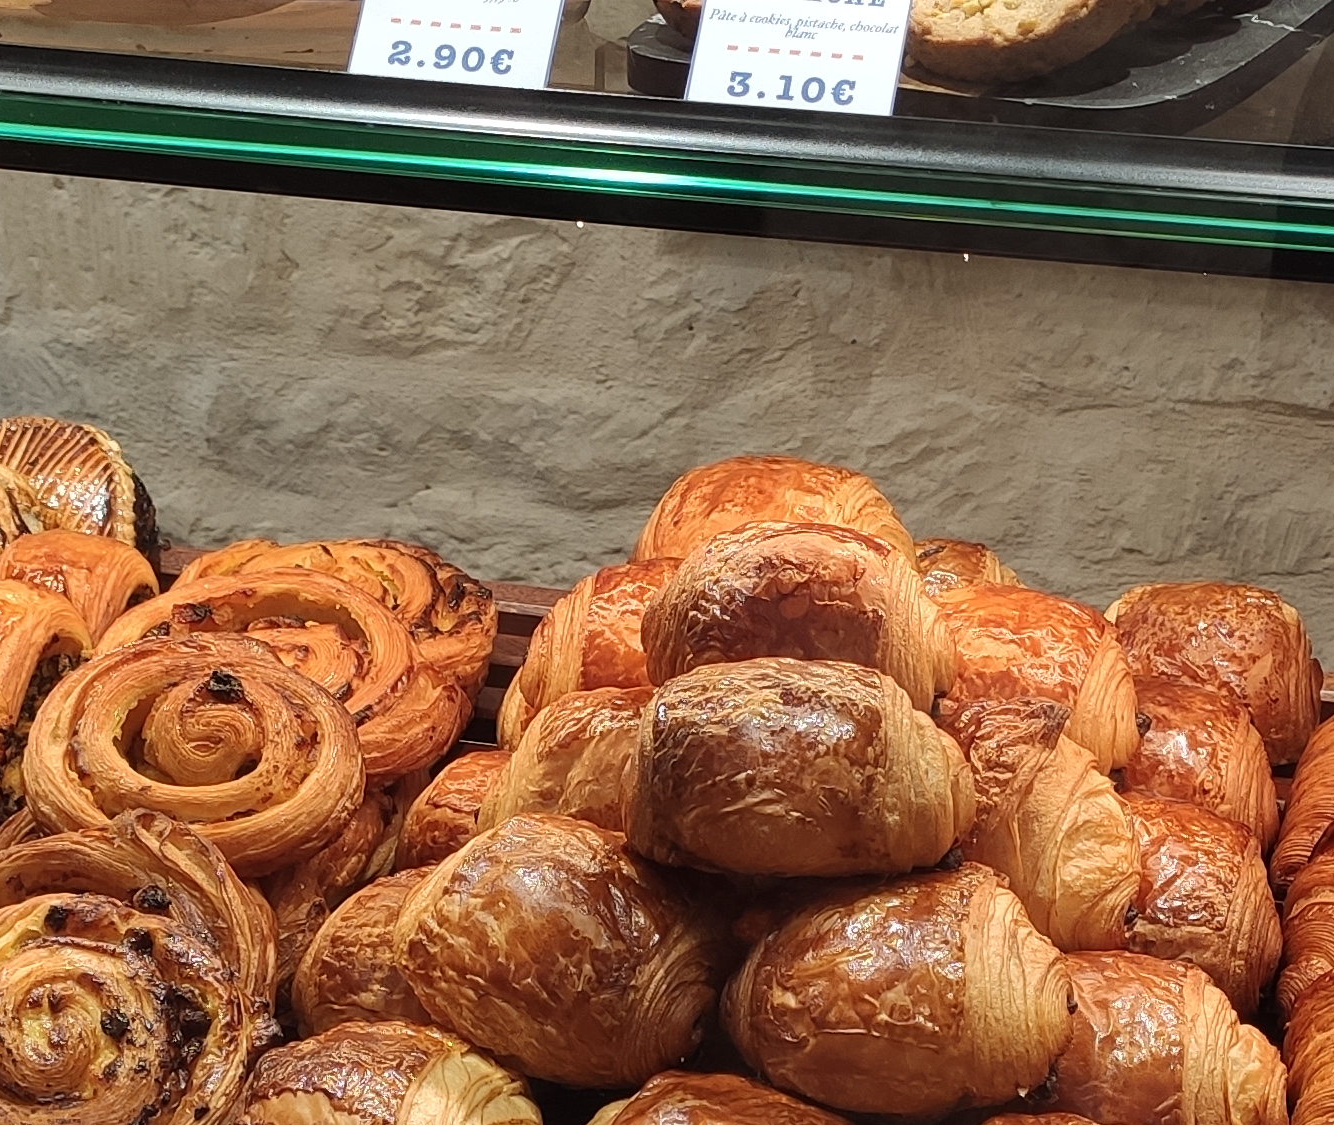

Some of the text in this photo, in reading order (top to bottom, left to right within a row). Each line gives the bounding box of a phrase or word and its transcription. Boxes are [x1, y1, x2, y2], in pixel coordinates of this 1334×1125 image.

[709, 8, 899, 34] Pâte à cookies, pistache, chocolat
[785, 27, 818, 40] blanc
[388, 40, 514, 75] 2.90€
[727, 71, 856, 105] 3.10€
